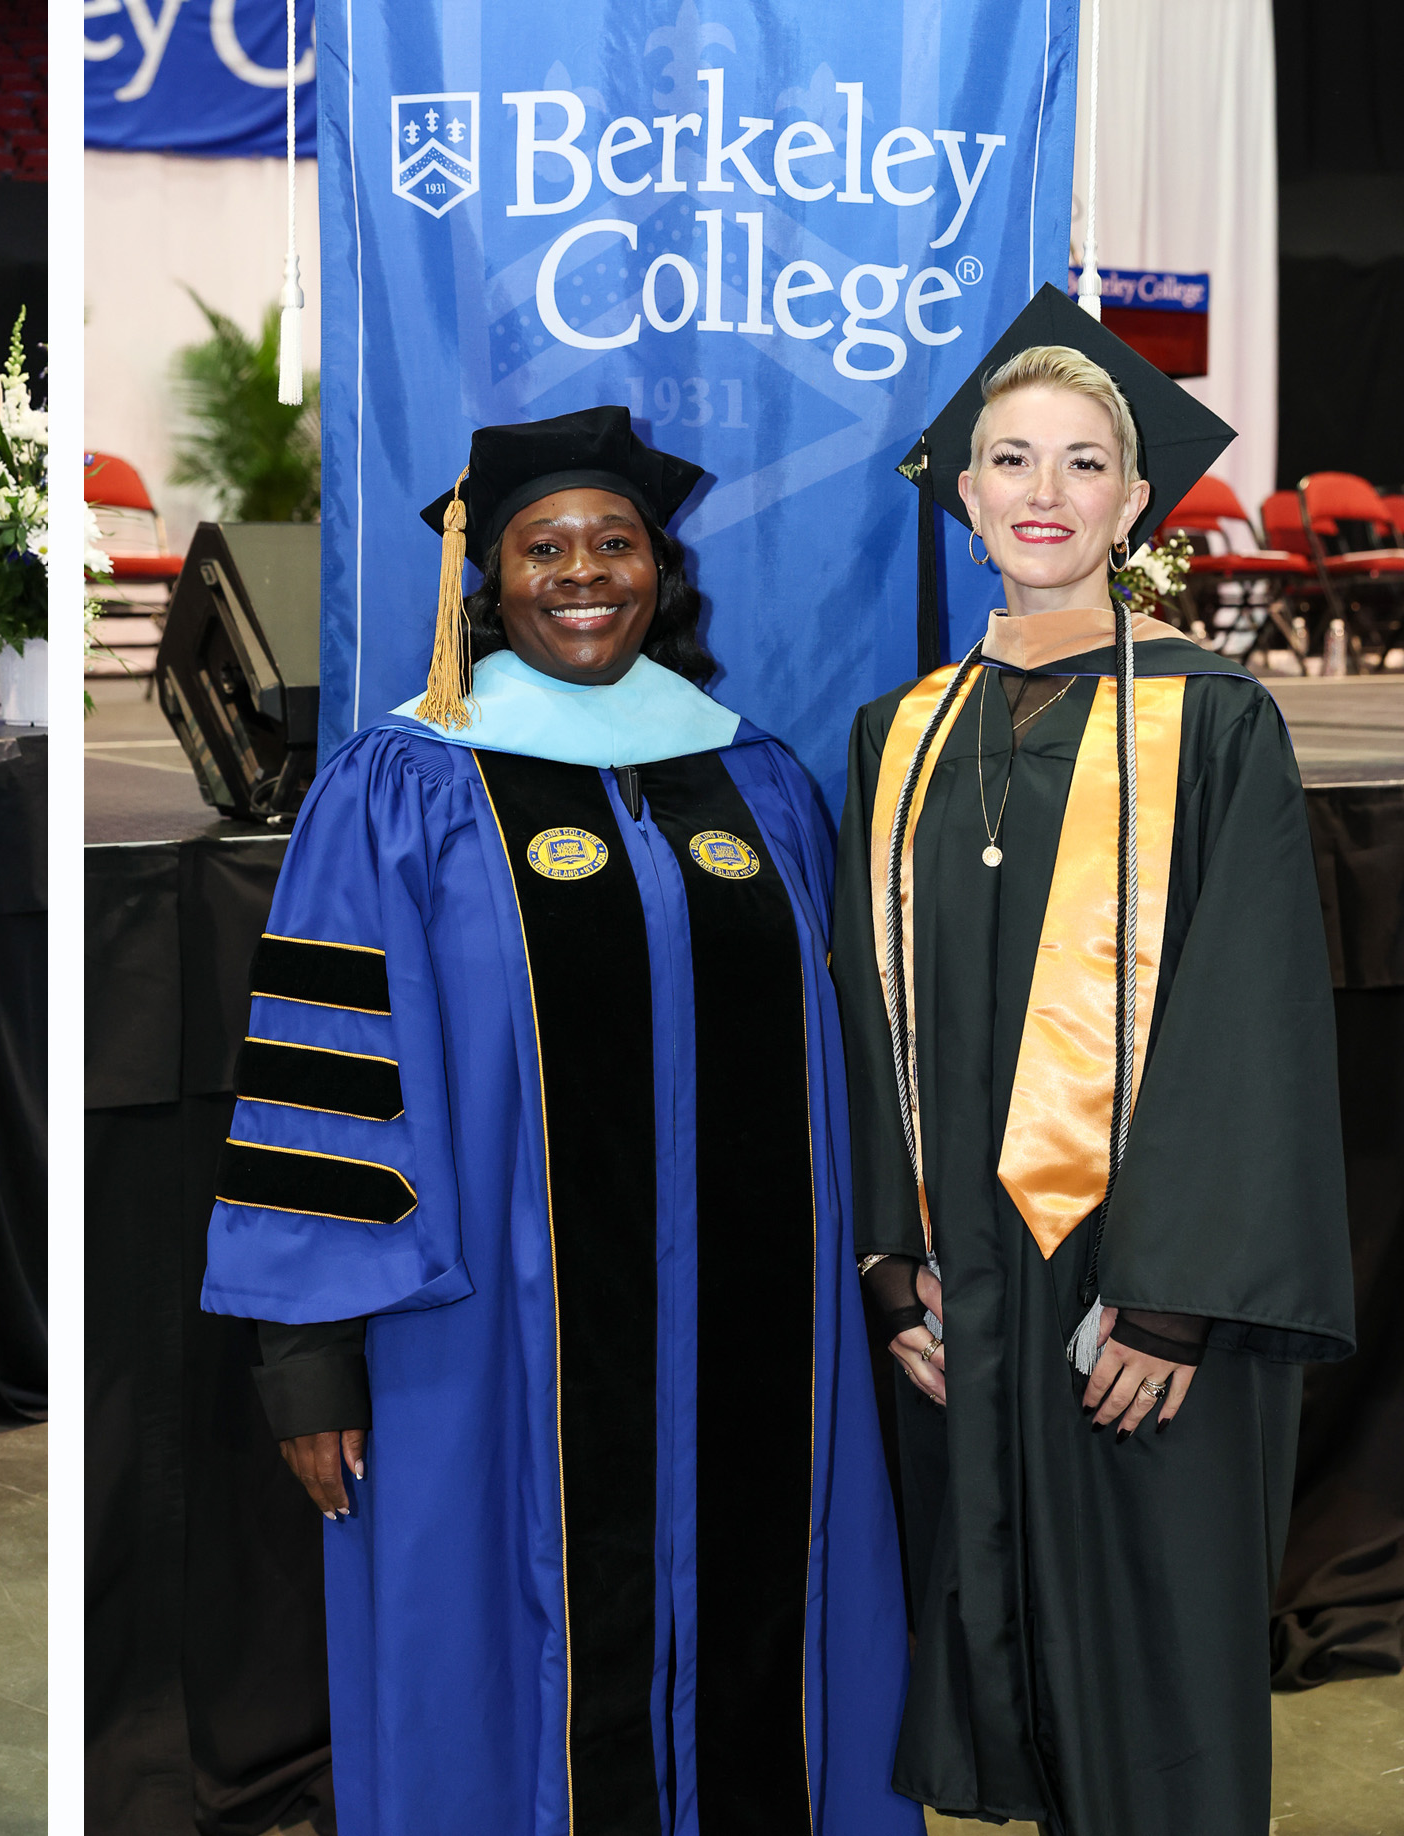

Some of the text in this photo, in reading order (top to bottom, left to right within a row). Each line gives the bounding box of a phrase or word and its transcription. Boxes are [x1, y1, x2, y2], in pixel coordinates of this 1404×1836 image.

[502, 68, 1005, 249] Berkeley
[424, 182, 447, 195] 1931
[1137, 274, 1205, 308] College
[624, 376, 749, 429] 1931
[530, 829, 601, 852] DOWLING COLLEGE
[532, 859, 551, 875] LONG
[550, 868, 580, 878] ISLAND
